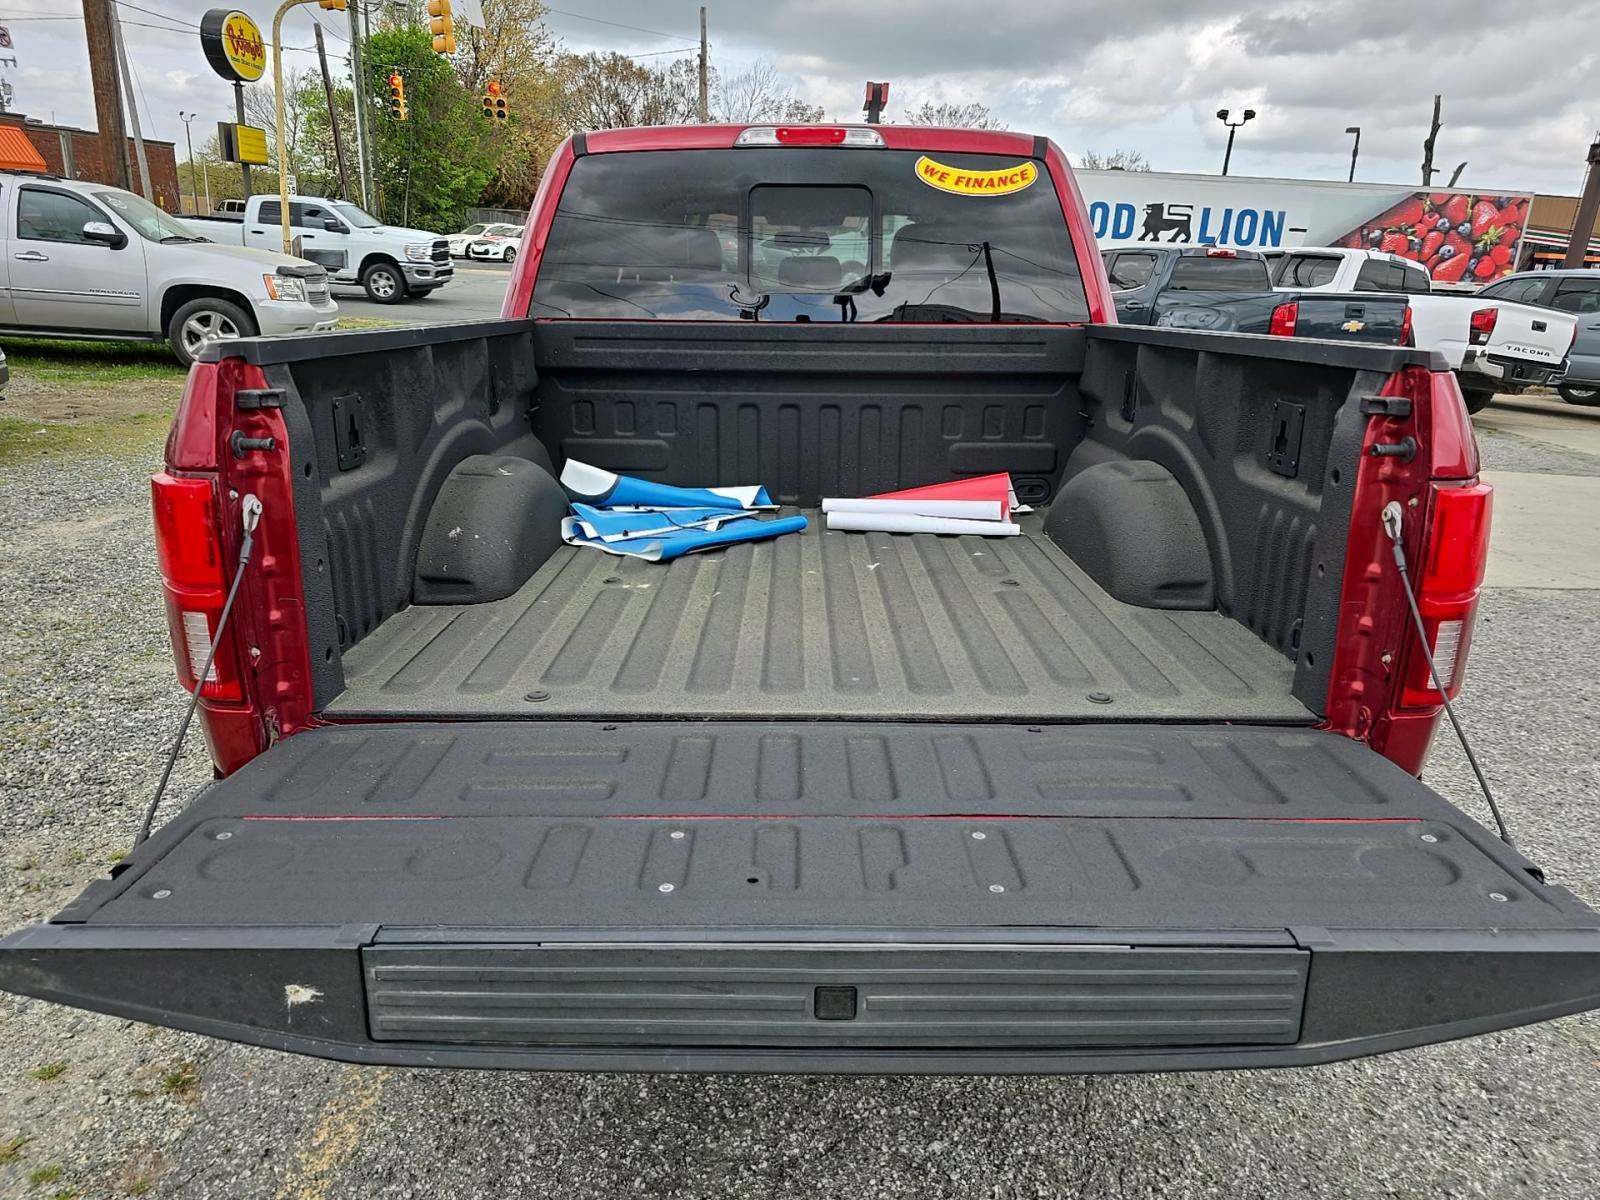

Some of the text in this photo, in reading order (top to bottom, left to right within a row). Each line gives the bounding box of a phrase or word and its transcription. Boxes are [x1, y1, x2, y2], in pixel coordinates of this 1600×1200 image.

[923, 164, 1030, 189] WE FINANCE
[1197, 207, 1287, 248] LION
[1506, 345, 1551, 357] TACOMA
